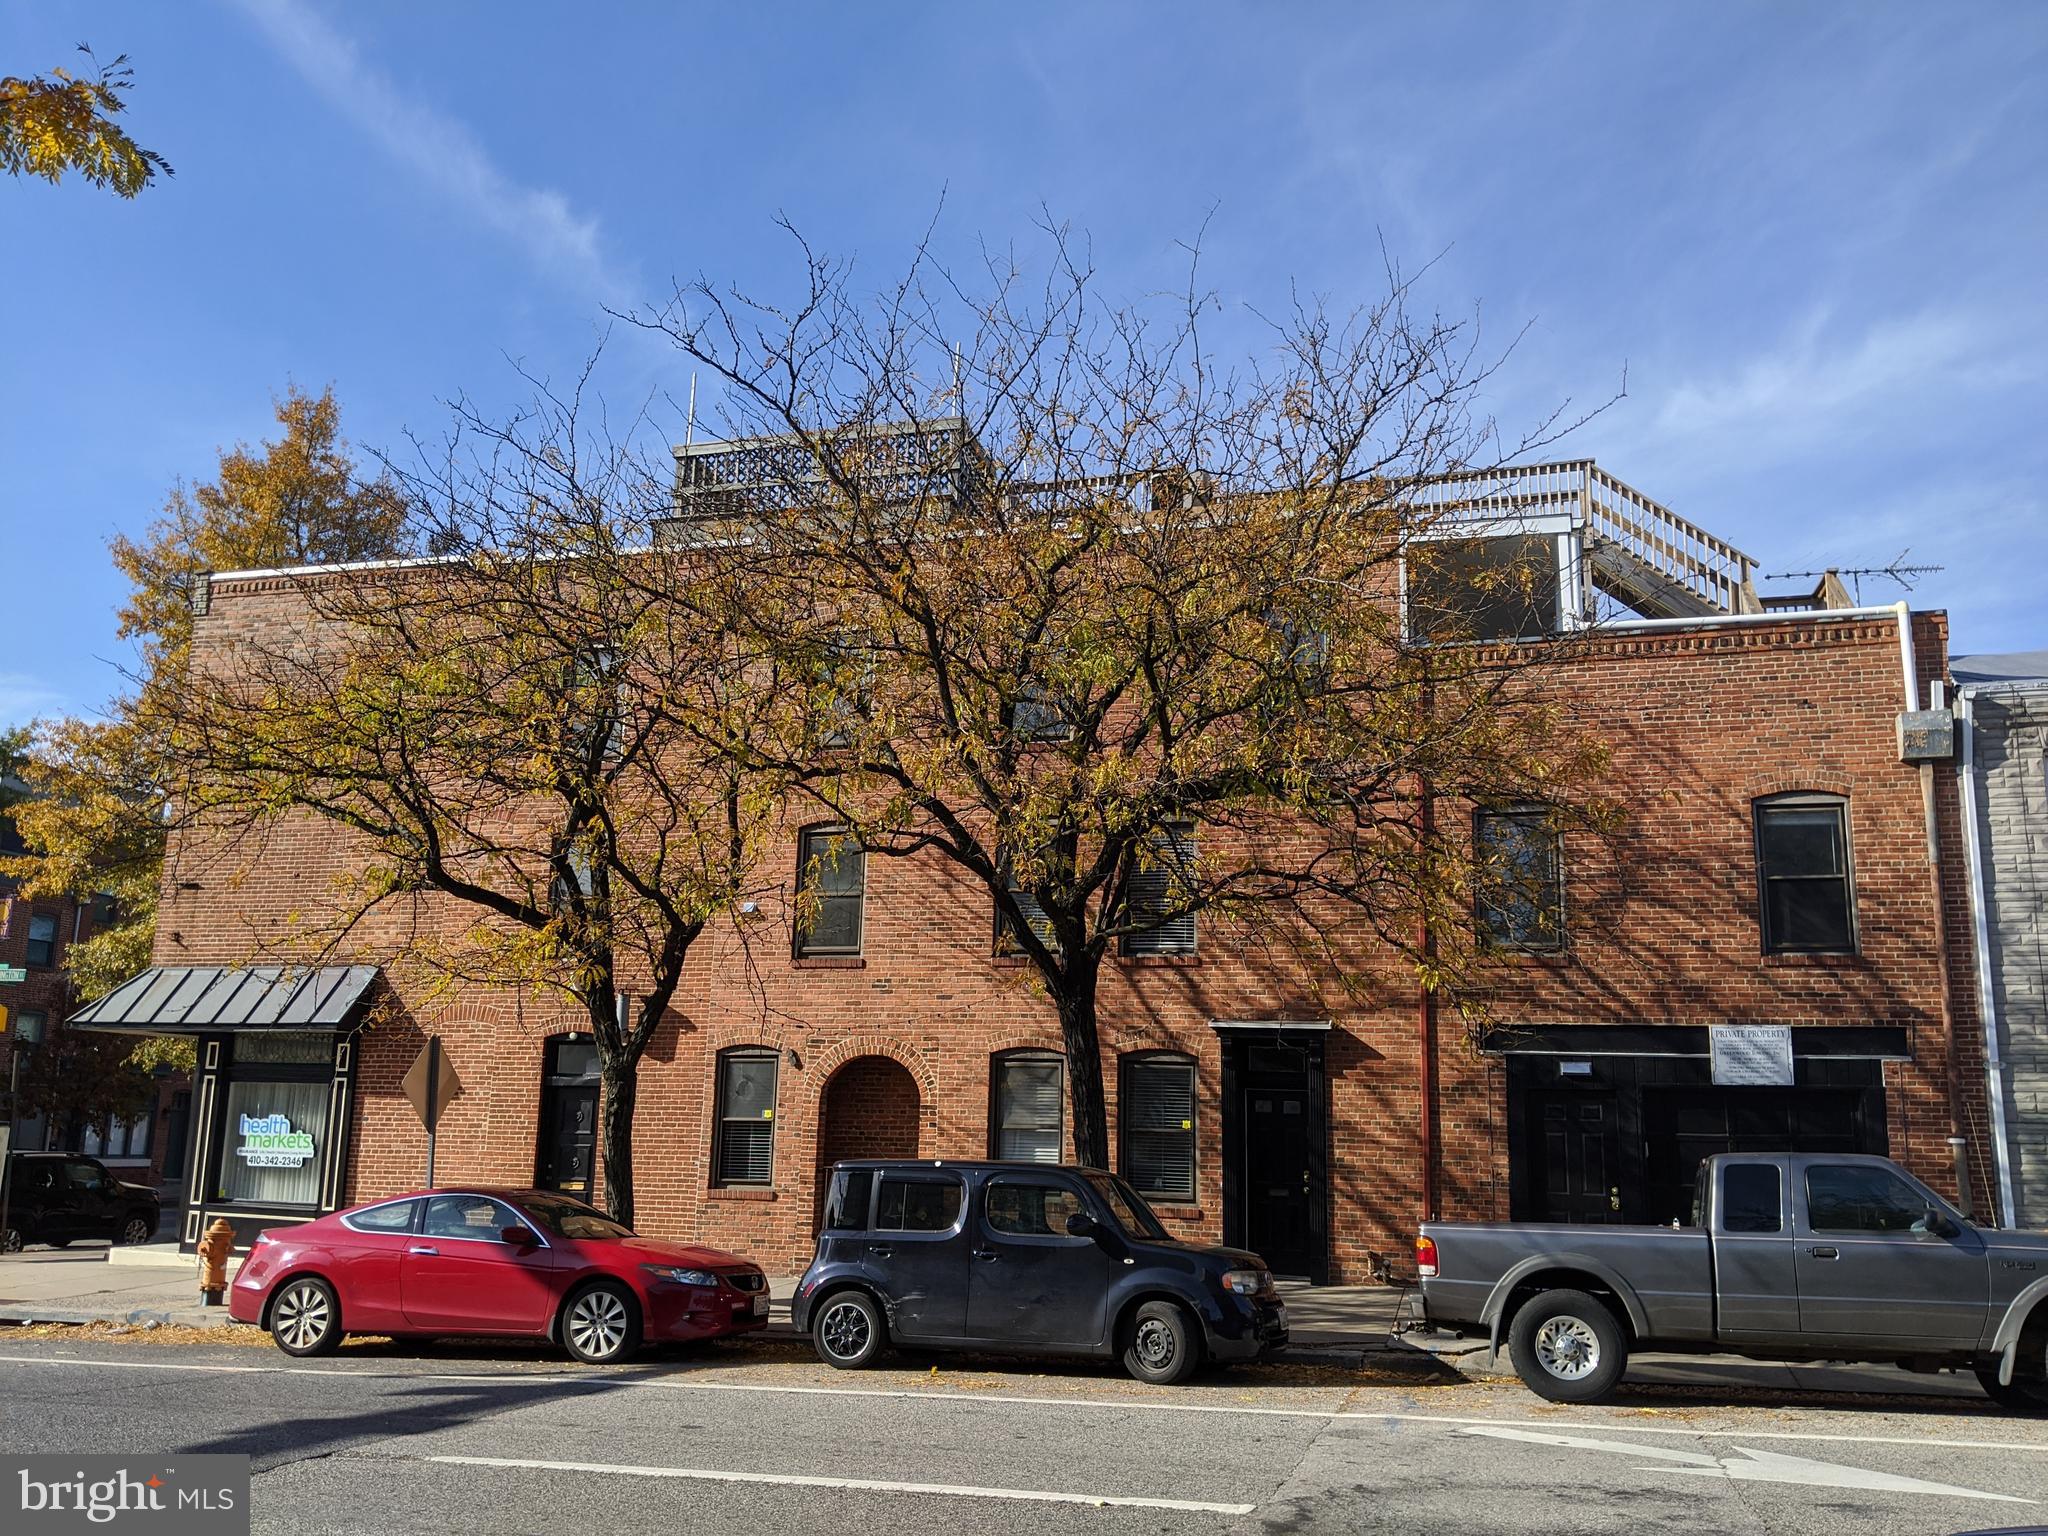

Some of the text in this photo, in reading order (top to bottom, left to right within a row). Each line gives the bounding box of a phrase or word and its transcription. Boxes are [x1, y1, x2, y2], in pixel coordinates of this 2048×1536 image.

[1715, 1029, 1786, 1038] PRIVATE PROPERTY
[241, 1115, 288, 1134] health
[247, 1132, 311, 1149] markets
[248, 1155, 302, 1166] 410-342-2346
